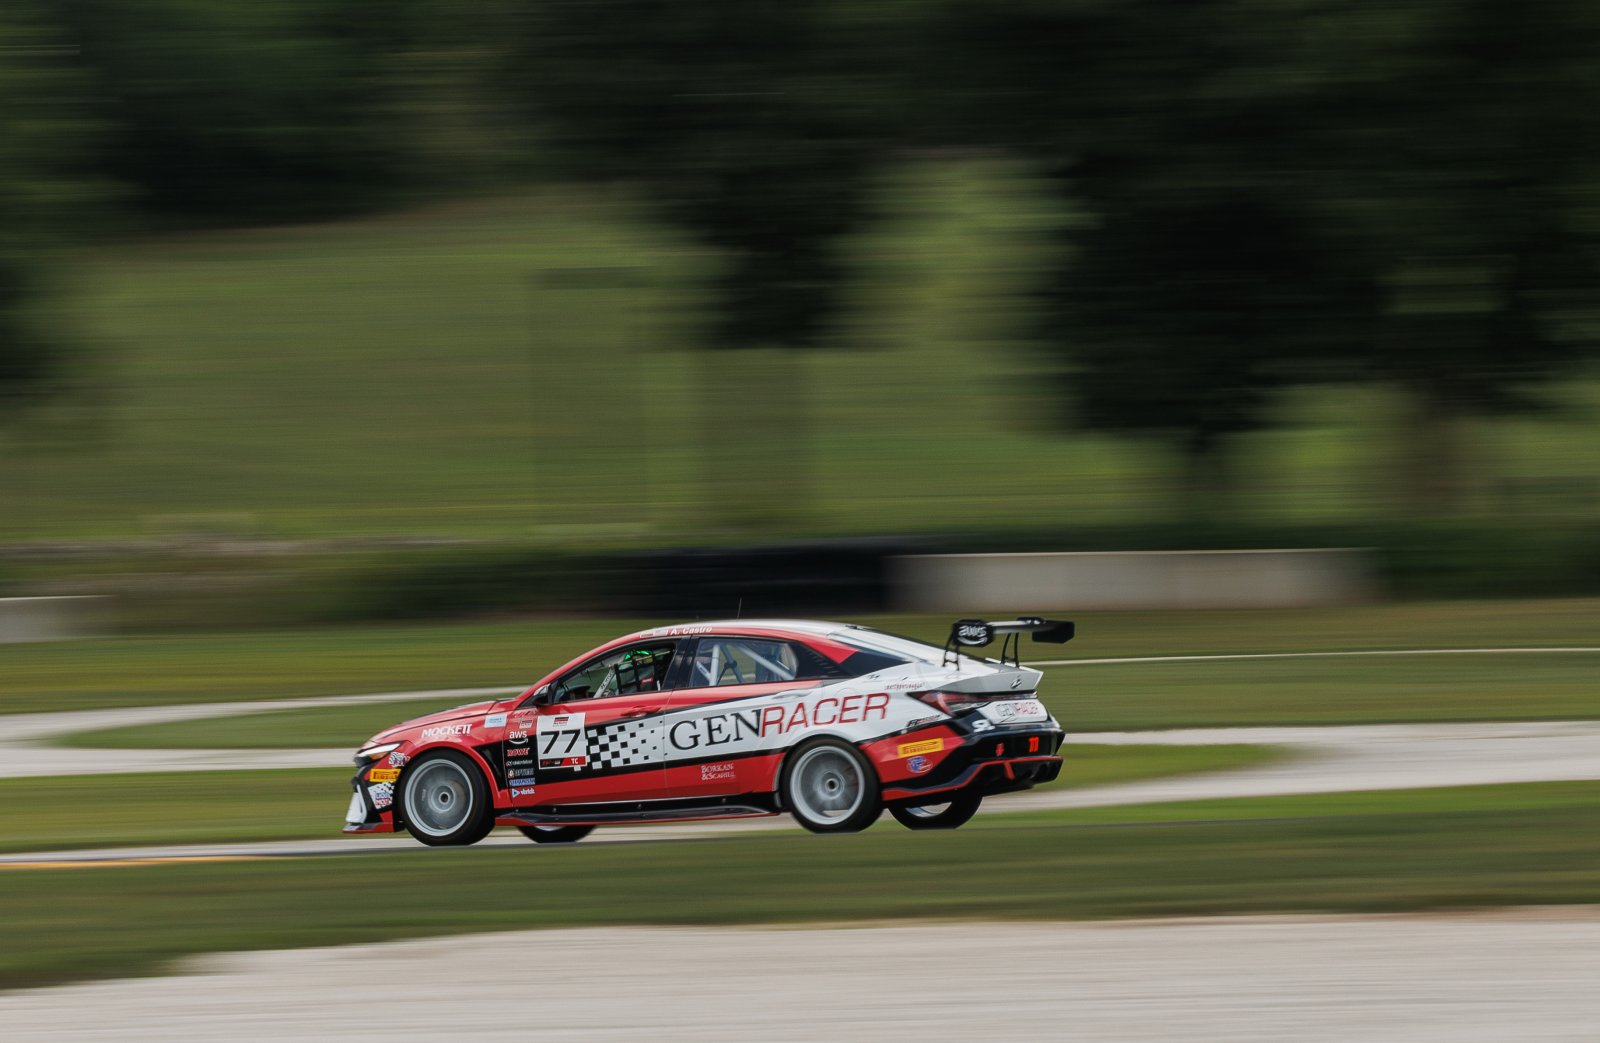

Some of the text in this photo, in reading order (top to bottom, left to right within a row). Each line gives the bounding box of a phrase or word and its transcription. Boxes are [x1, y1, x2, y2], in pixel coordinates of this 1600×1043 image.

[421, 724, 472, 738] MOCKETT
[669, 692, 890, 751] GENRACER
[509, 730, 527, 739] aws
[540, 729, 581, 754] 77
